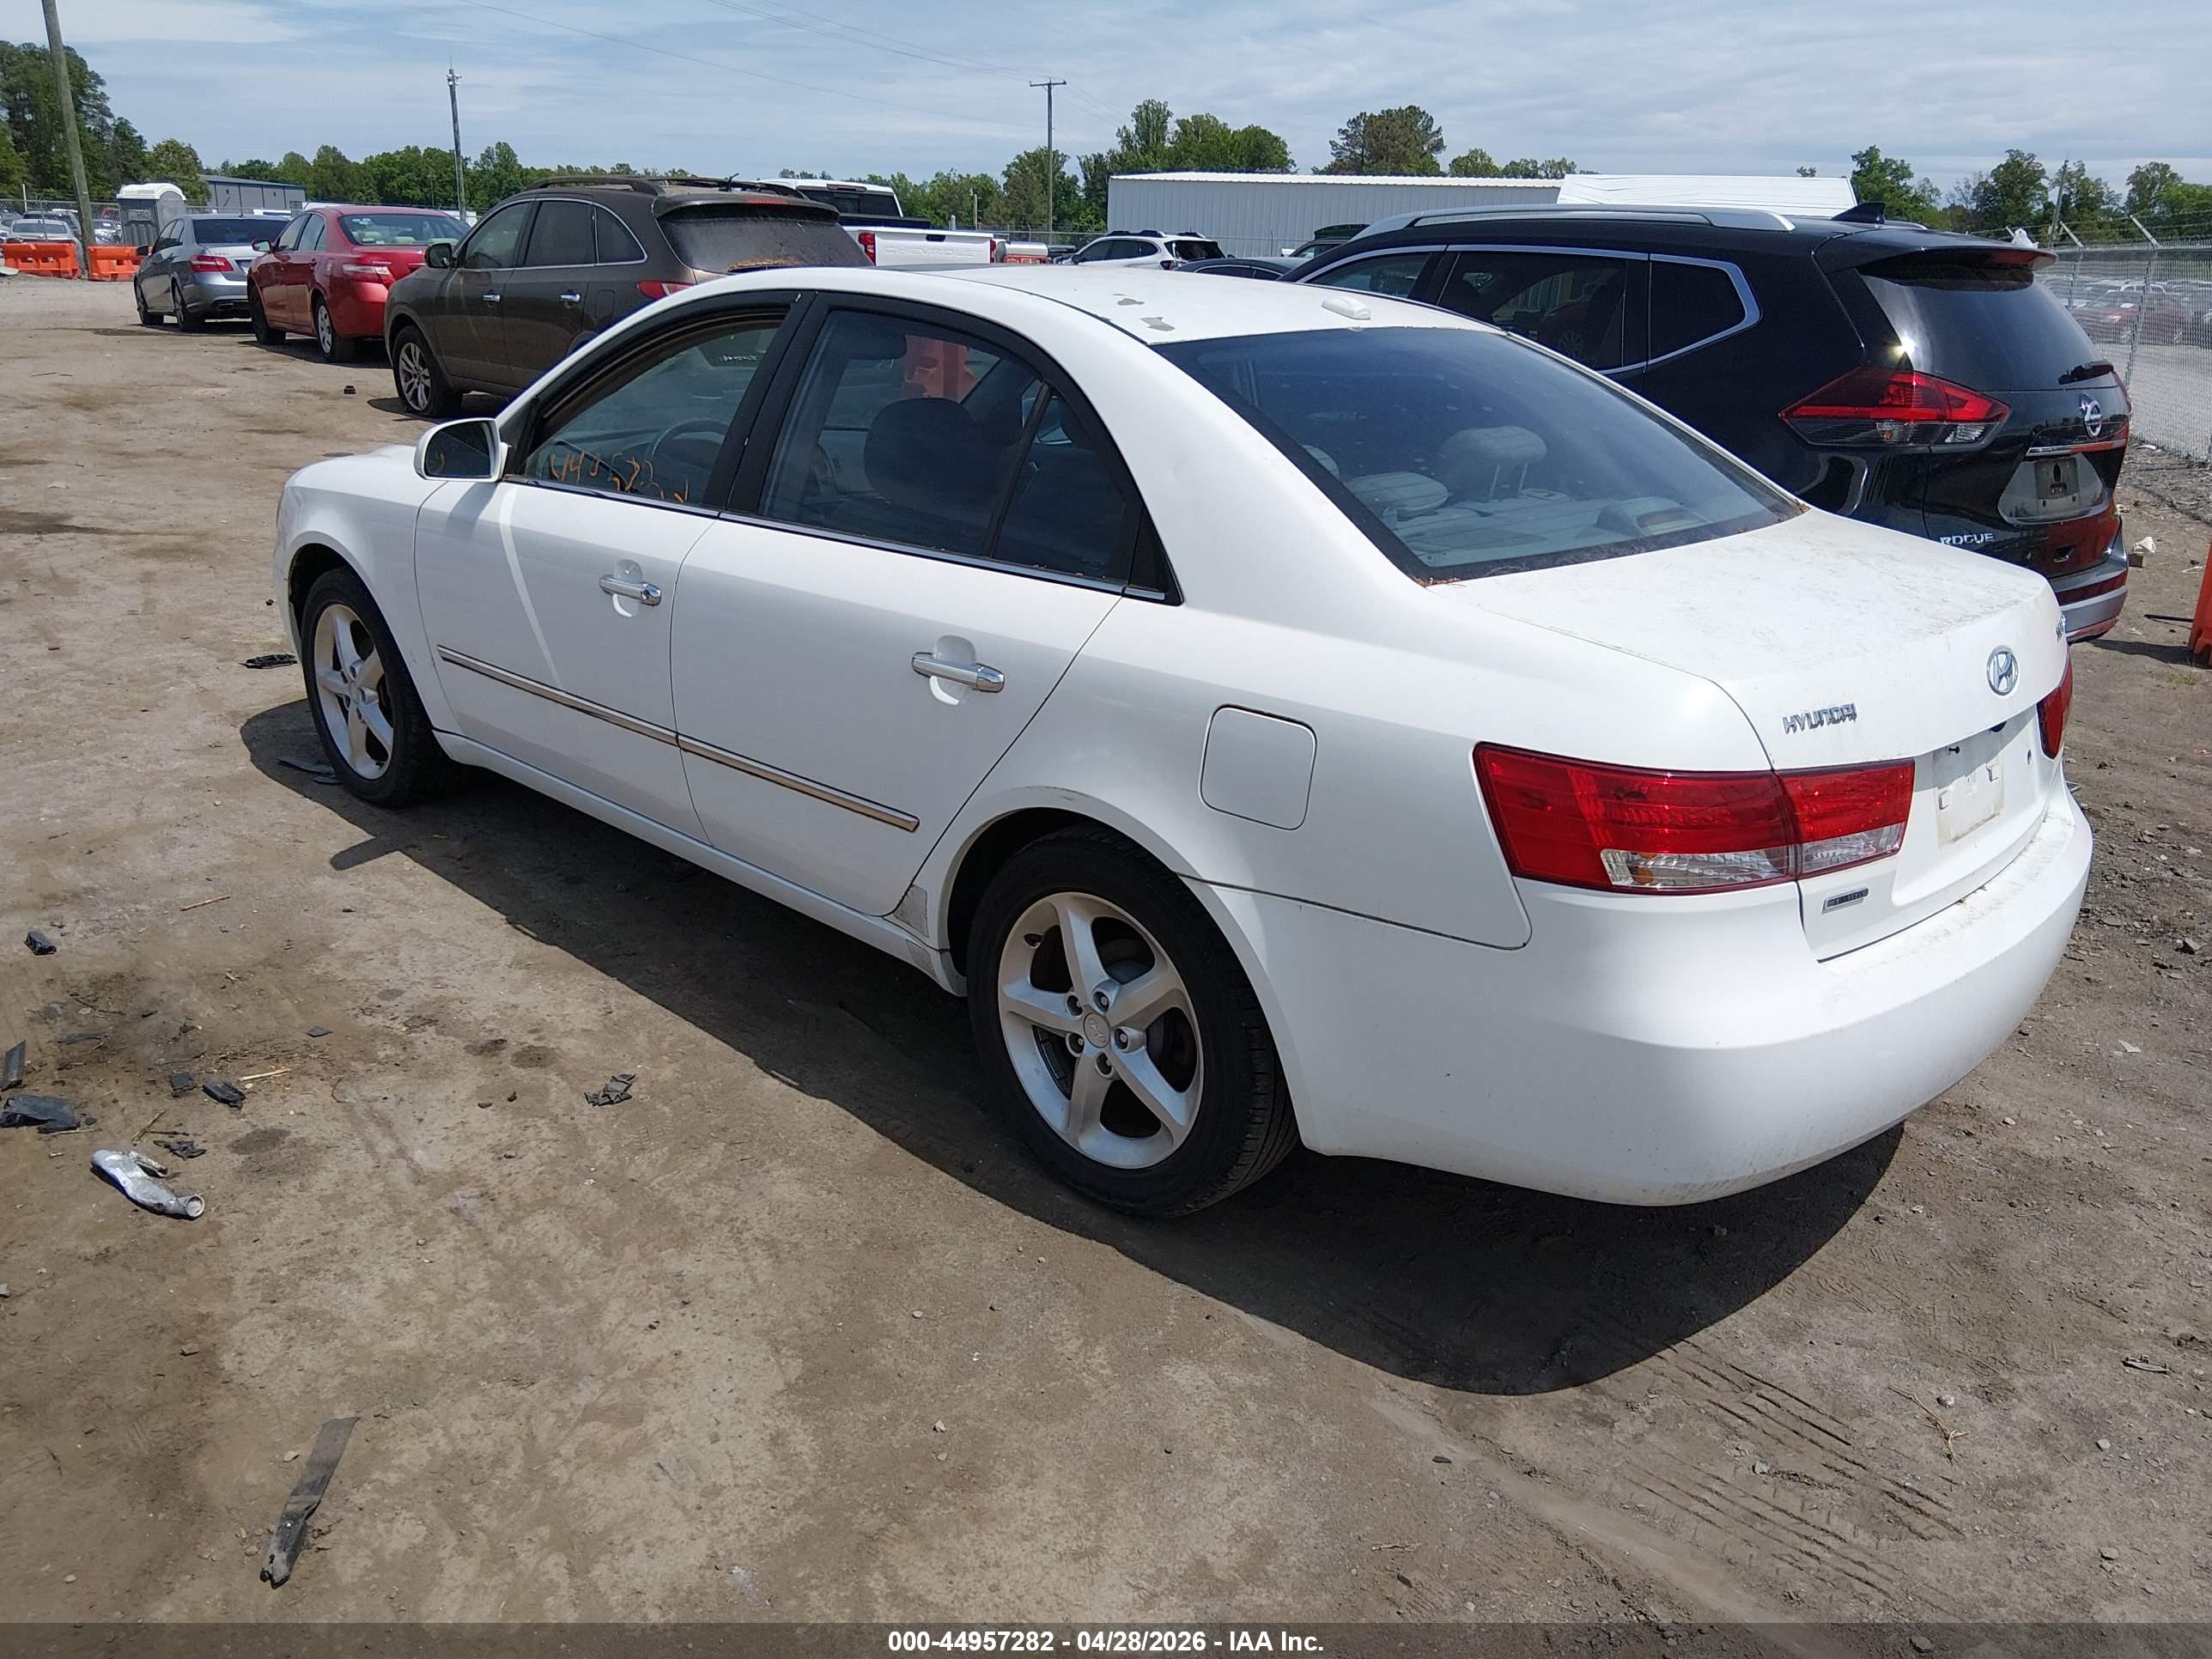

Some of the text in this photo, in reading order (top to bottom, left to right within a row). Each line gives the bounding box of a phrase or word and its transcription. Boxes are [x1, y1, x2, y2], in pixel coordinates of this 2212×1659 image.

[884, 246, 984, 258] CHEVROLET
[1940, 532, 1994, 545] ROGUE
[1782, 702, 1857, 734] HYUNDAI
